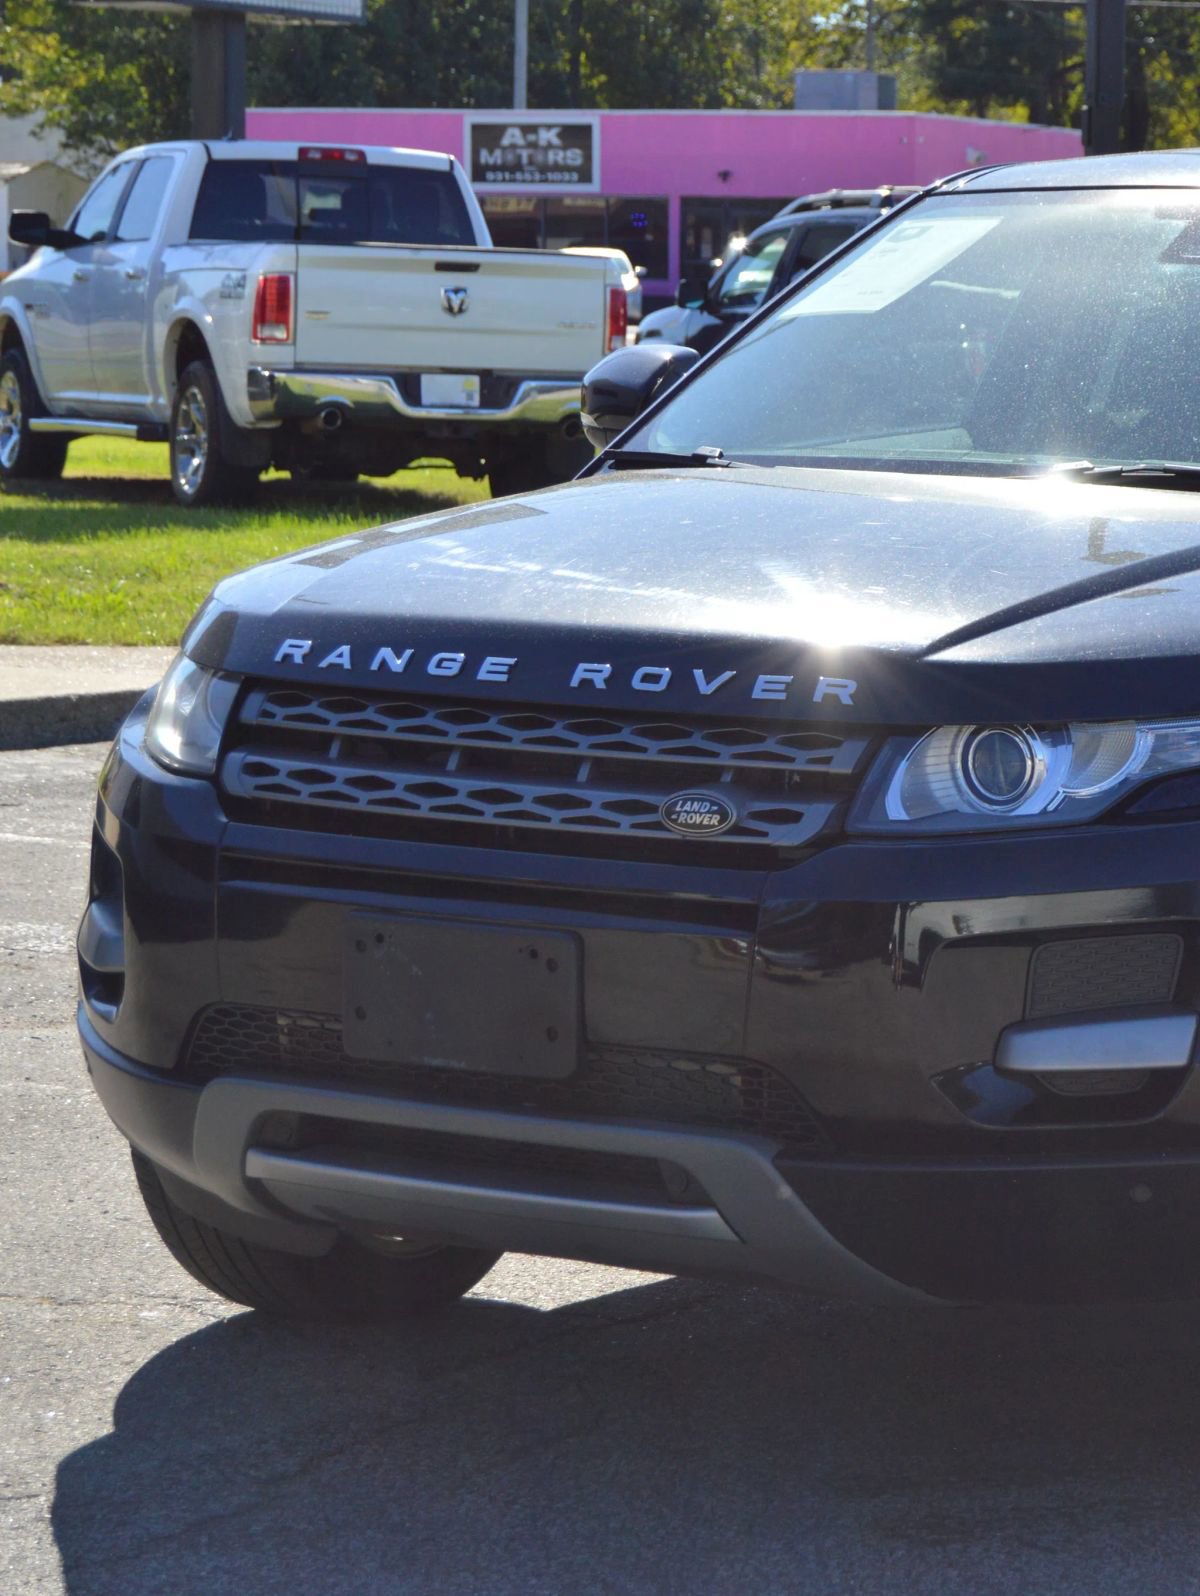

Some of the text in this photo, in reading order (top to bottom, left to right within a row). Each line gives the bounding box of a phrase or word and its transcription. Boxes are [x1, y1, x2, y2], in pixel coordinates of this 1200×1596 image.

[501, 126, 562, 147] A-K
[274, 638, 857, 705] RANGE ROVER
